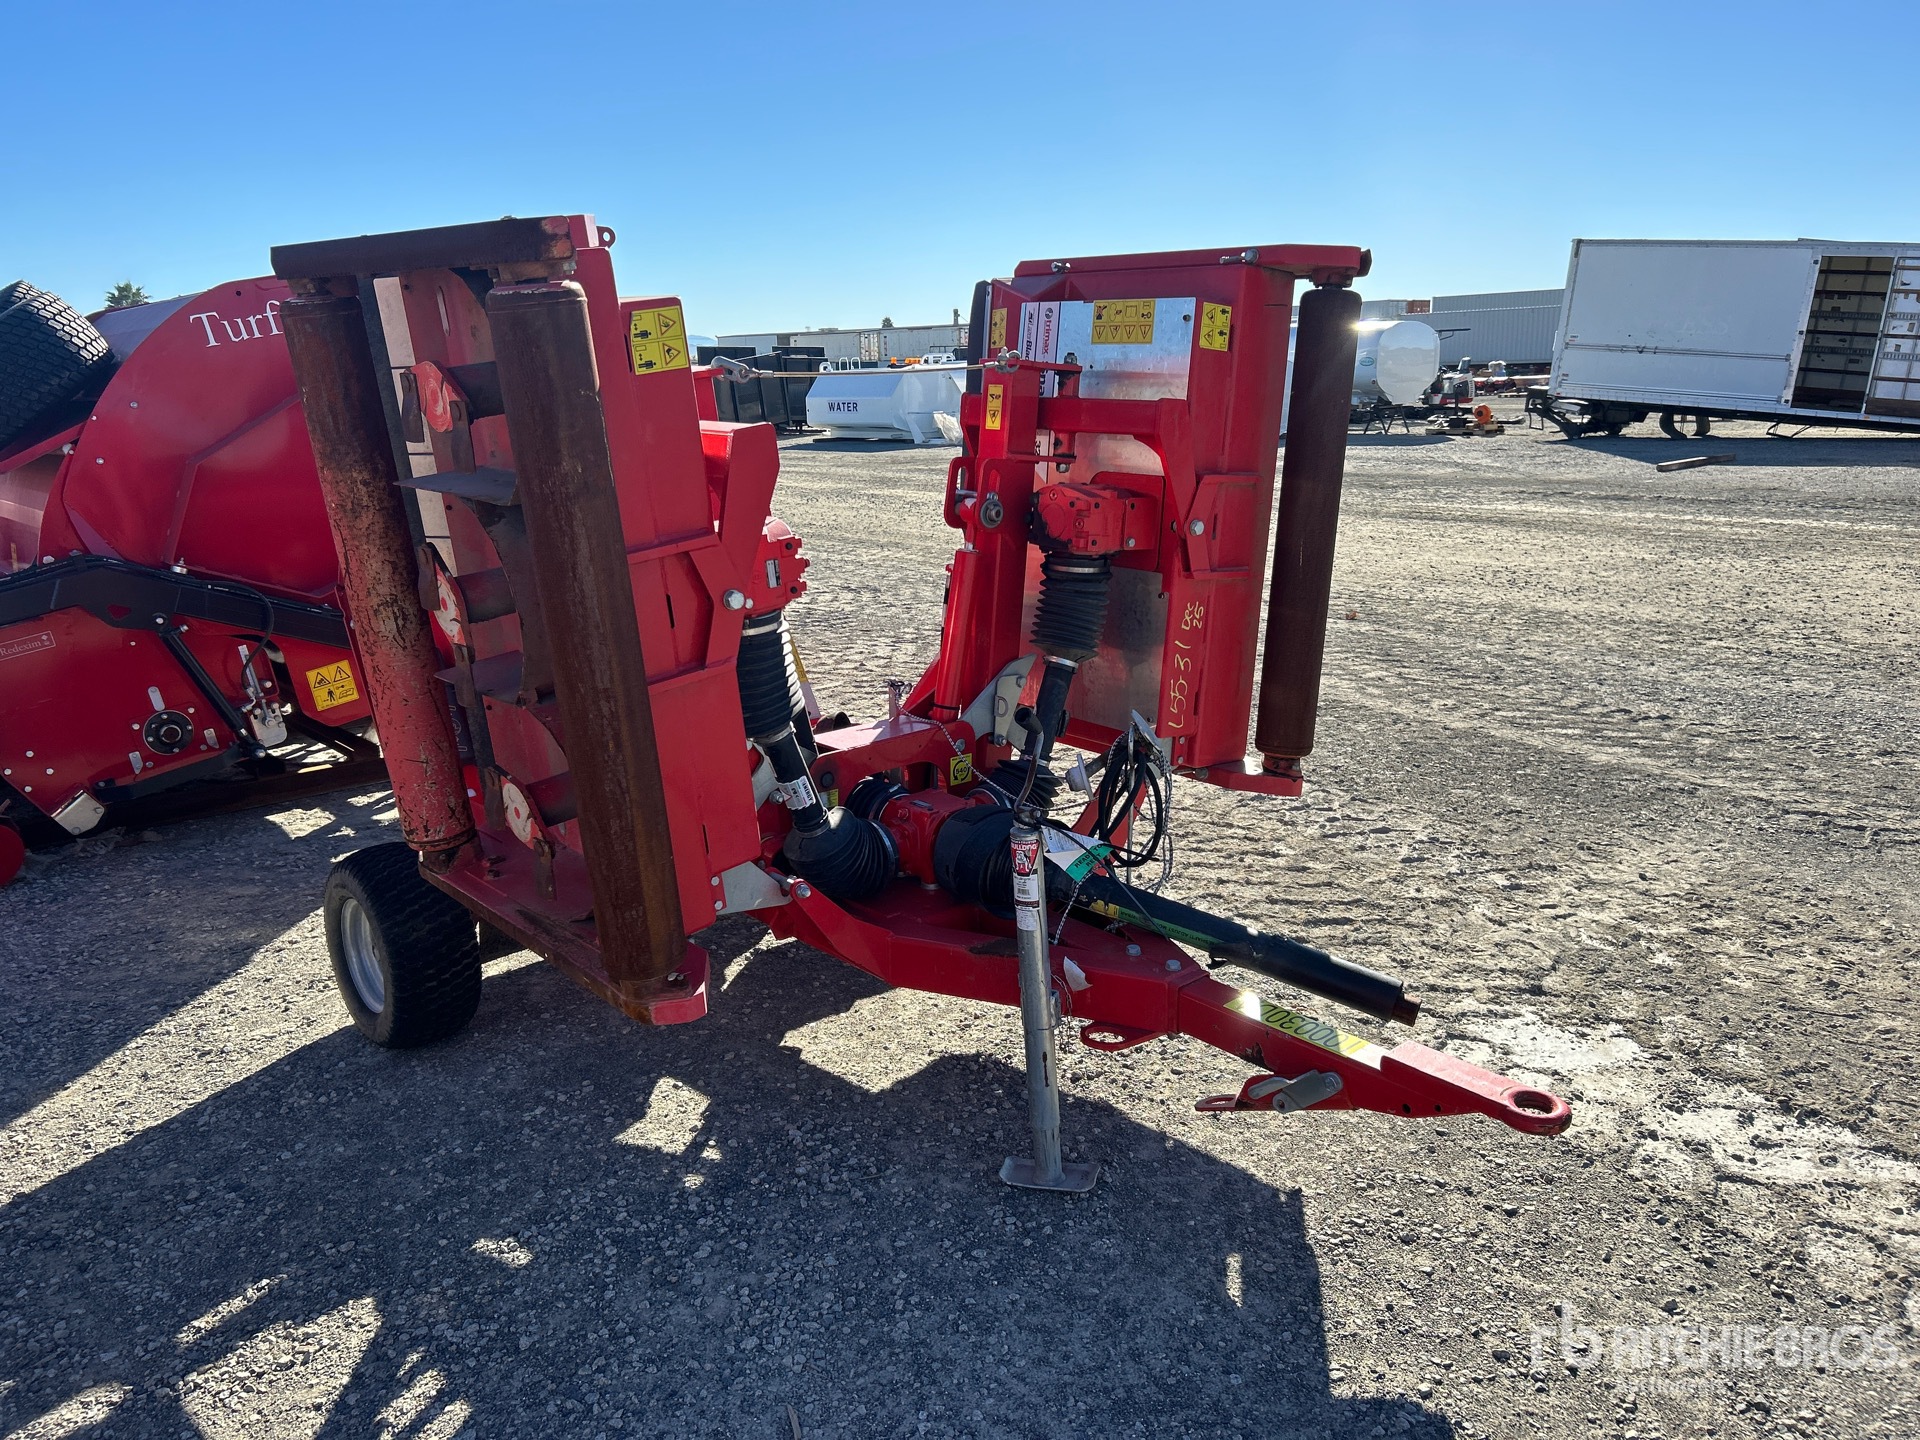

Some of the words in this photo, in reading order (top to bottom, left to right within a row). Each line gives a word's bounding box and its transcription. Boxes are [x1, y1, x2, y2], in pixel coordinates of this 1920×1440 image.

[189, 300, 283, 347] Turf
[1044, 320, 1053, 355] trimax
[828, 402, 858, 412] WATER
[1193, 601, 1204, 629] 25
[0, 640, 42, 657] Redexim
[1074, 853, 1092, 868] READ
